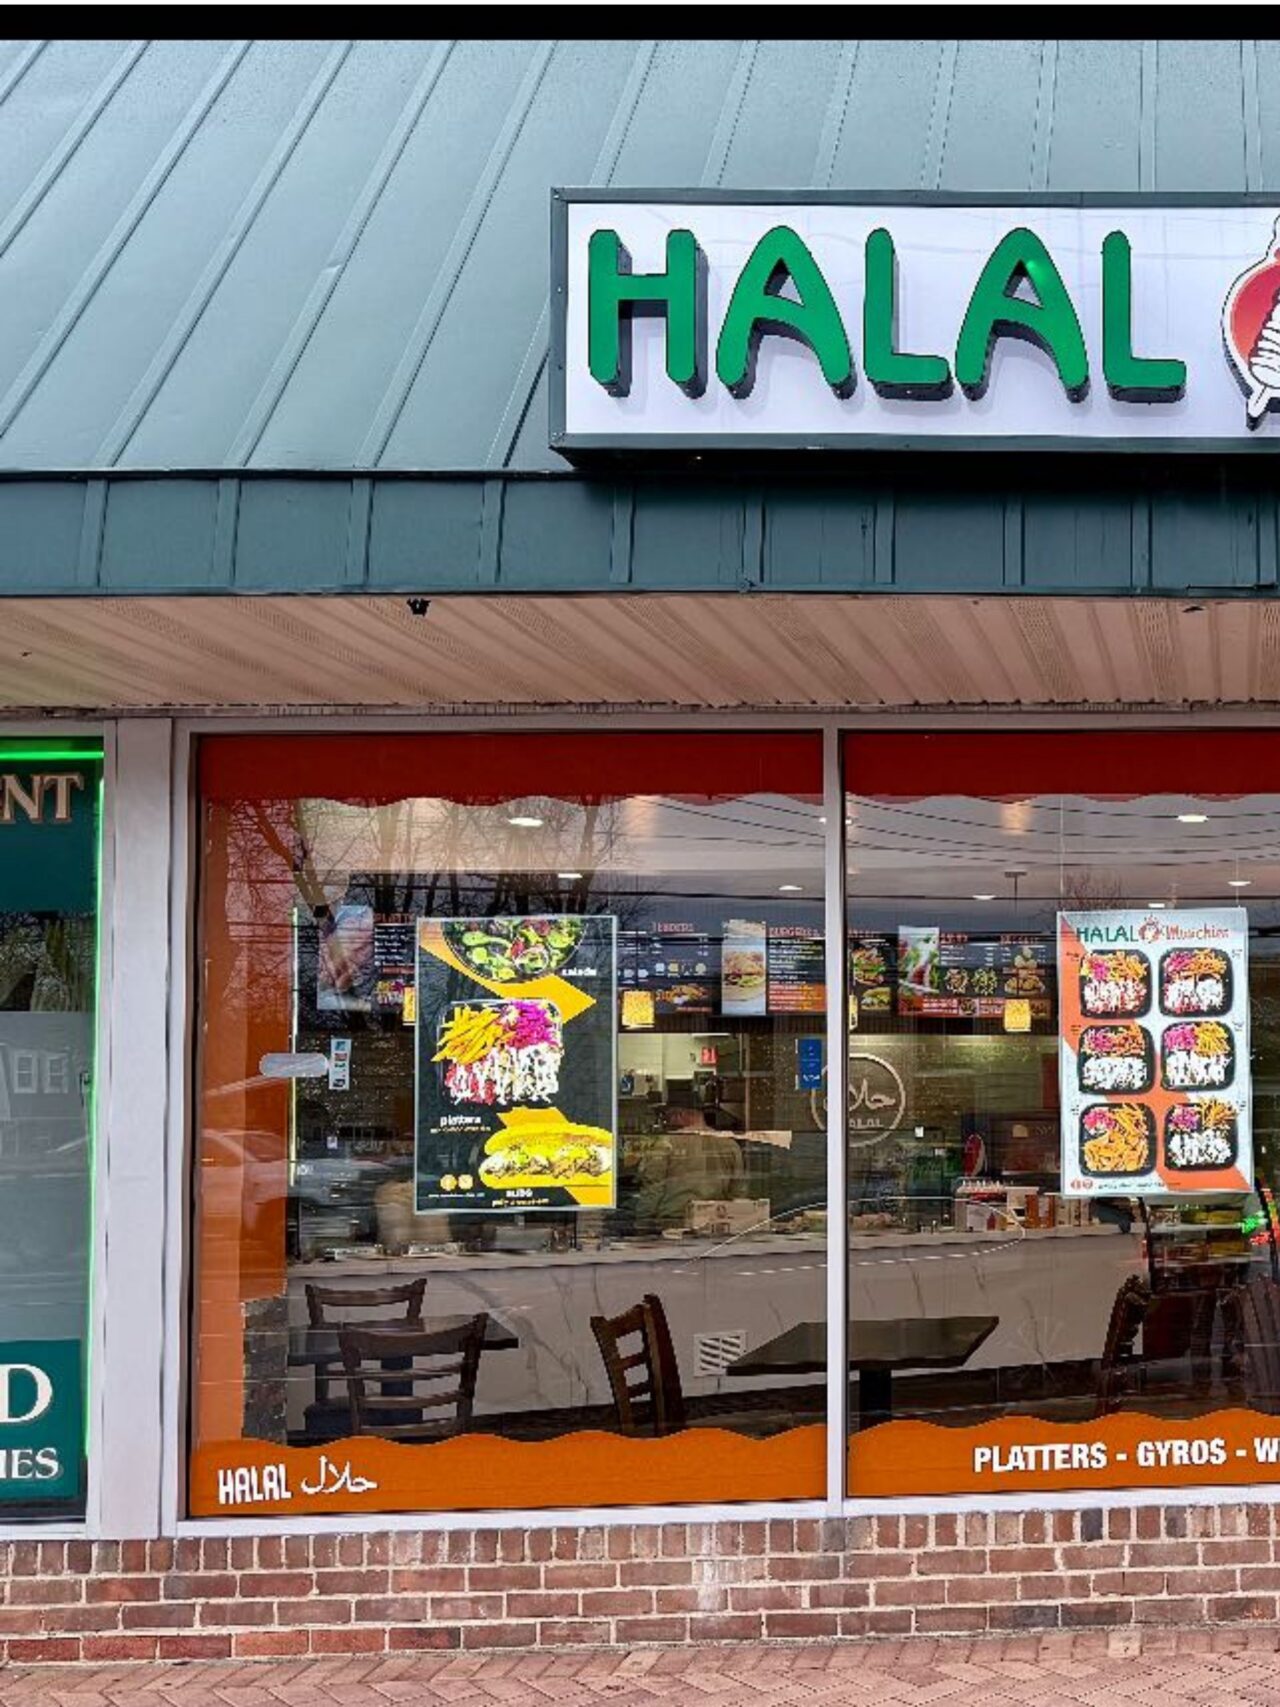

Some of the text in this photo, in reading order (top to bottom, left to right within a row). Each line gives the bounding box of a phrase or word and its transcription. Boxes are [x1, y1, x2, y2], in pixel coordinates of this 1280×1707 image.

[588, 225, 1188, 402] HALAL
[1077, 925, 1139, 942] HALAL
[301, 1455, 377, 1495] حلال
[974, 1442, 1107, 1473] PLATTERS
[1137, 1439, 1227, 1467] GYROS
[218, 1463, 292, 1505] HALAL
